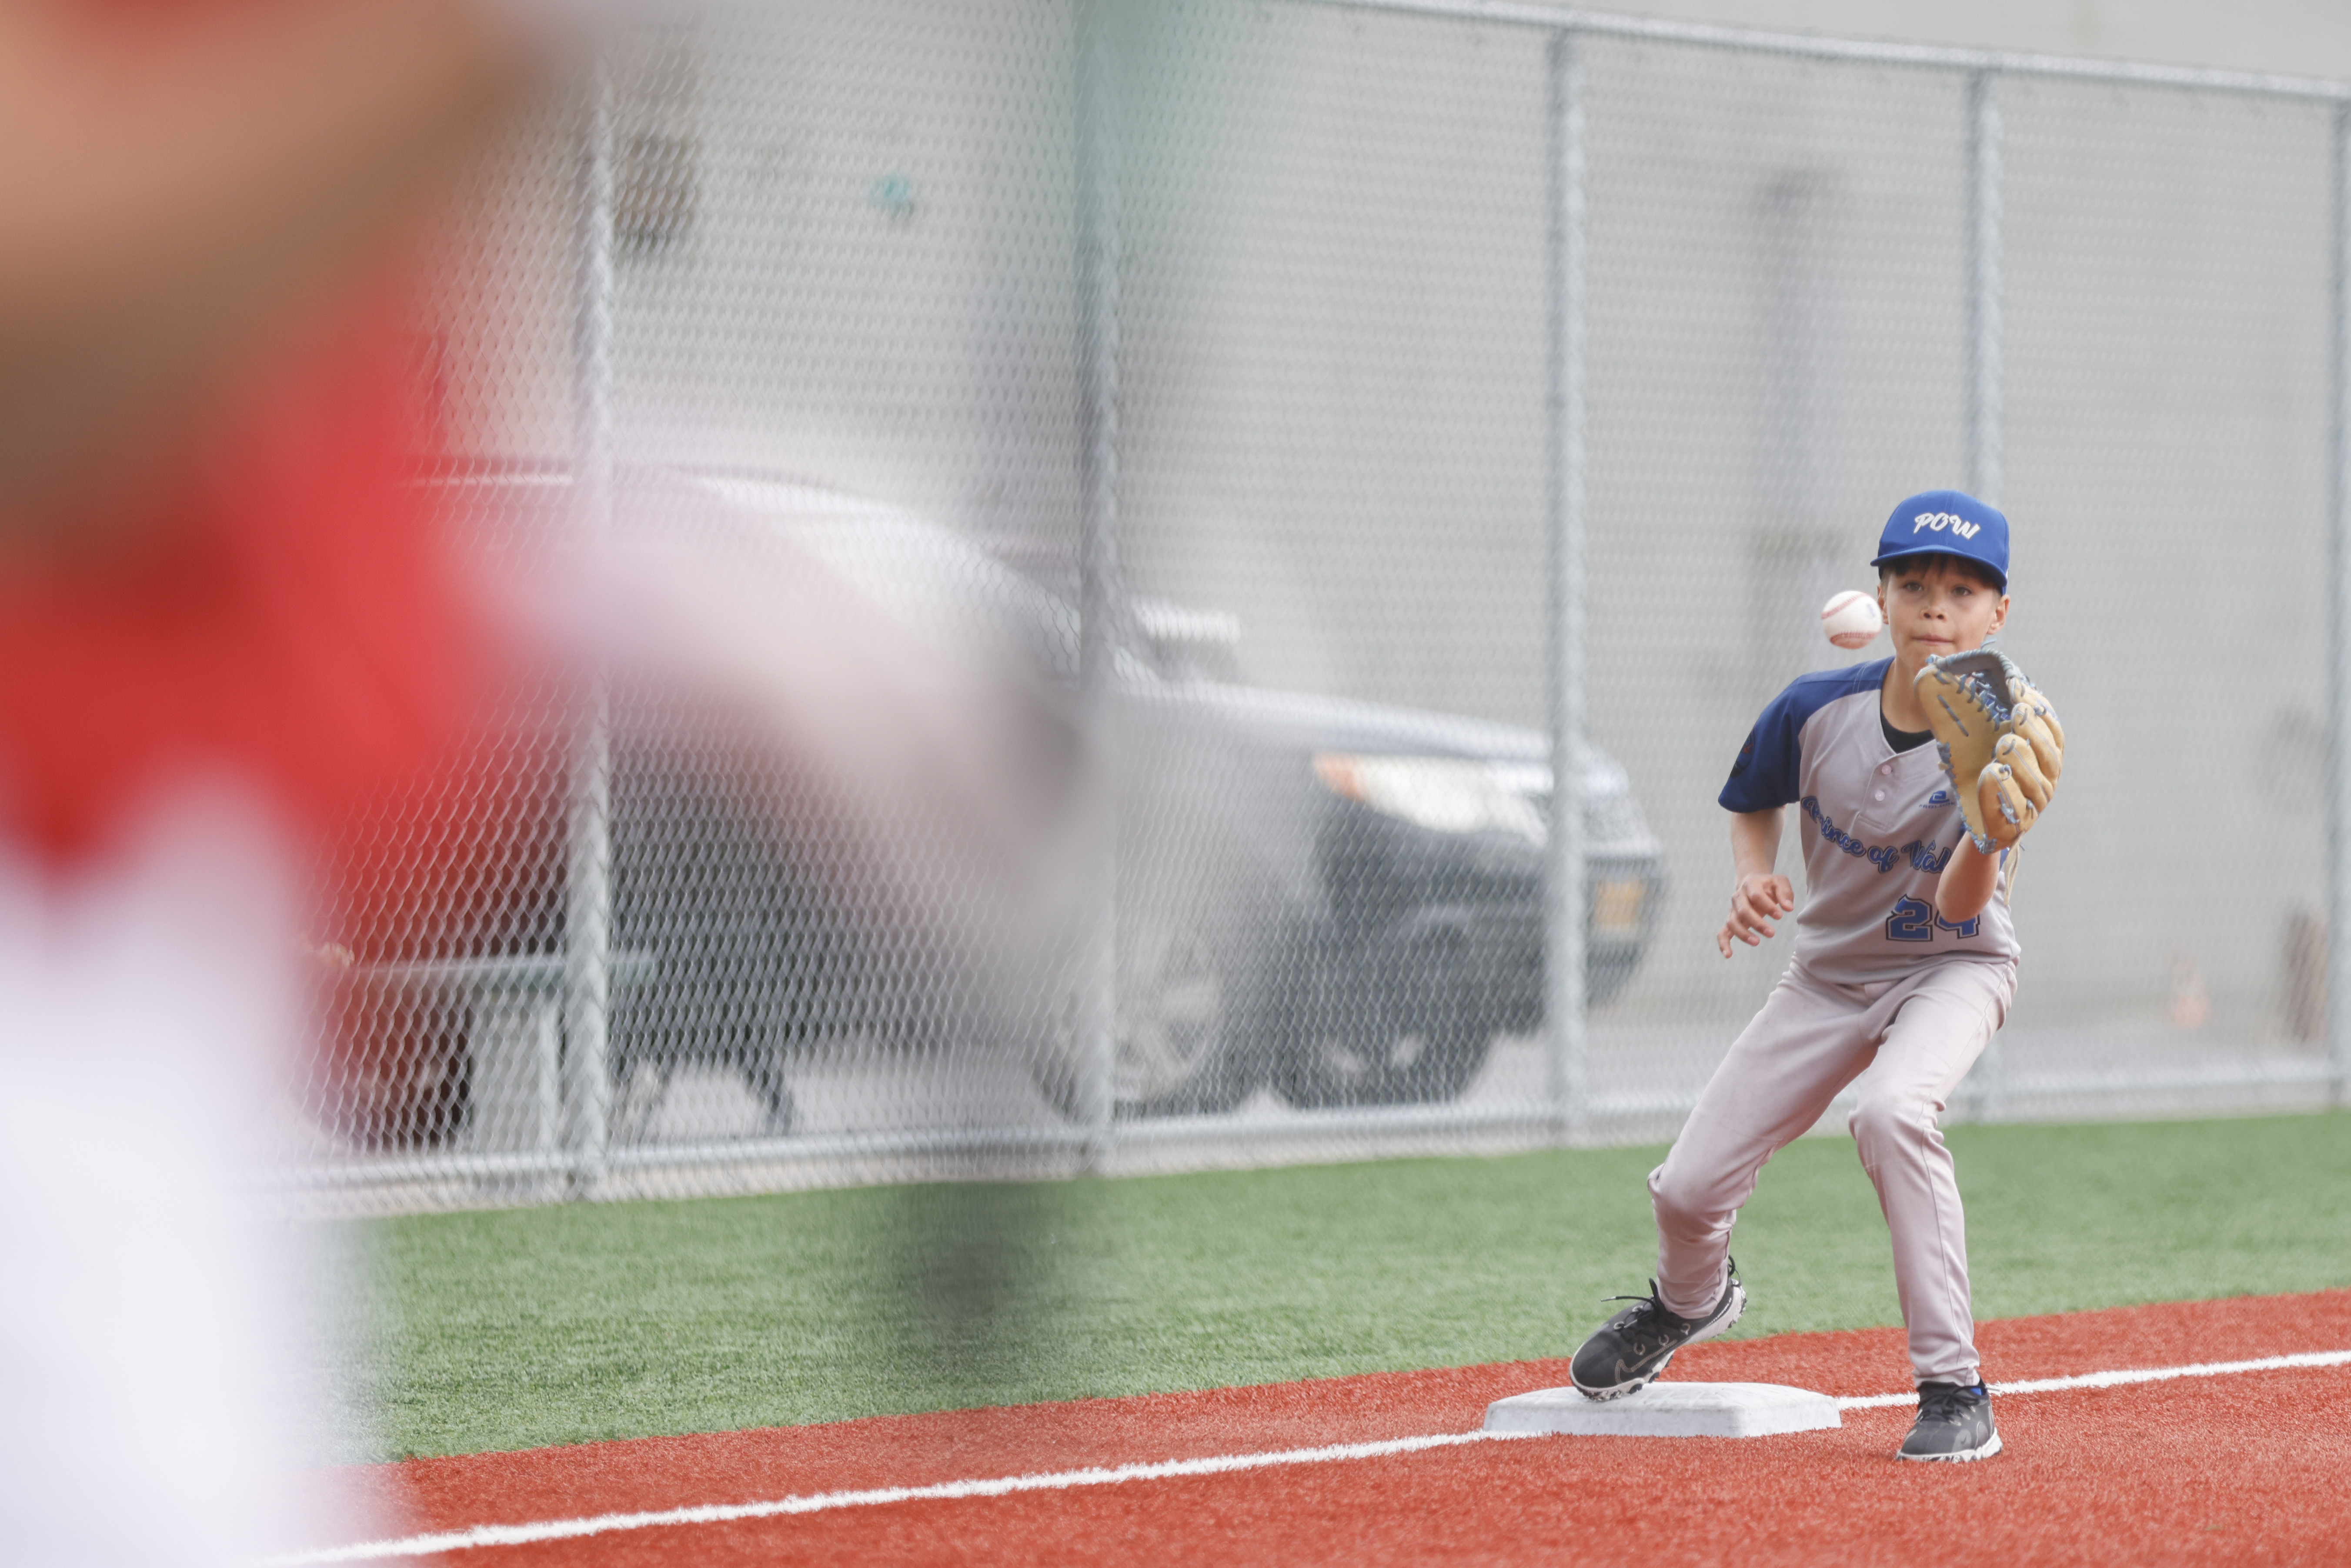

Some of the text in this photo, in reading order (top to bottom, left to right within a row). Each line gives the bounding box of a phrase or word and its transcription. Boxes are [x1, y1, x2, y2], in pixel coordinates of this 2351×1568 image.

[1914, 512, 1980, 540] POW
[1801, 796, 1951, 874] Prince of Wal
